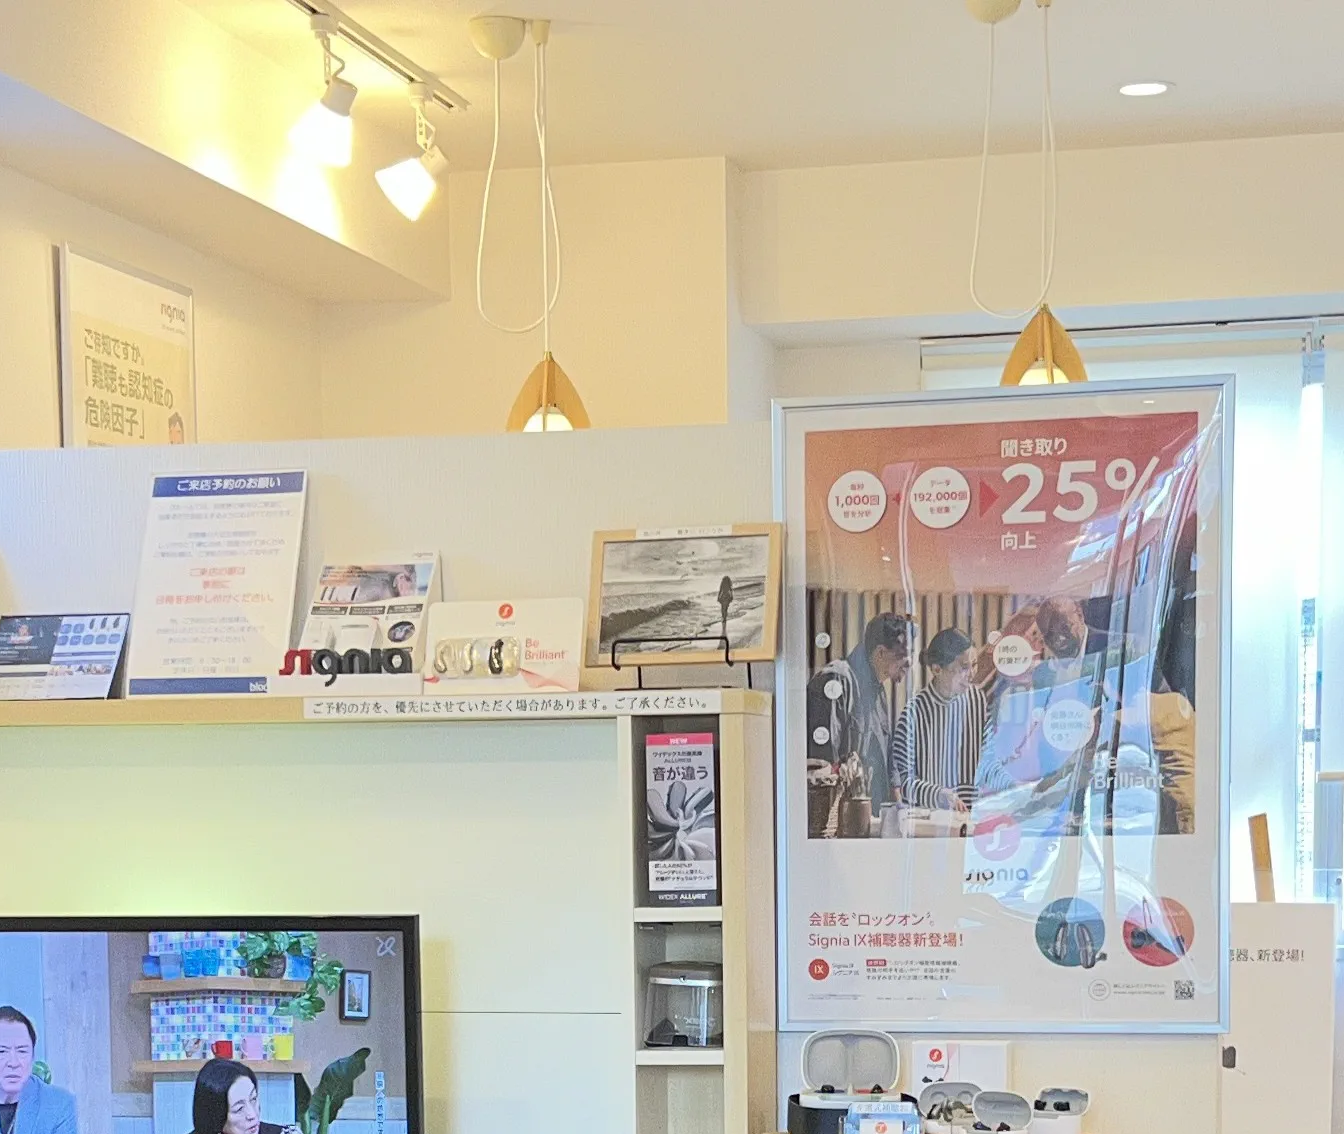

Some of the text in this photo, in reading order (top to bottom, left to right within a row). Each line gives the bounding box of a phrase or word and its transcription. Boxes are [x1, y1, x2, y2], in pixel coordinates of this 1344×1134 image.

[999, 437, 1069, 458] 聞き取り
[1000, 455, 1164, 525] 25%
[834, 494, 881, 508] 1,000回
[1000, 531, 1037, 551] 向上
[279, 646, 414, 688] signia
[653, 766, 708, 781] 音が違う
[808, 933, 850, 949] Signia
